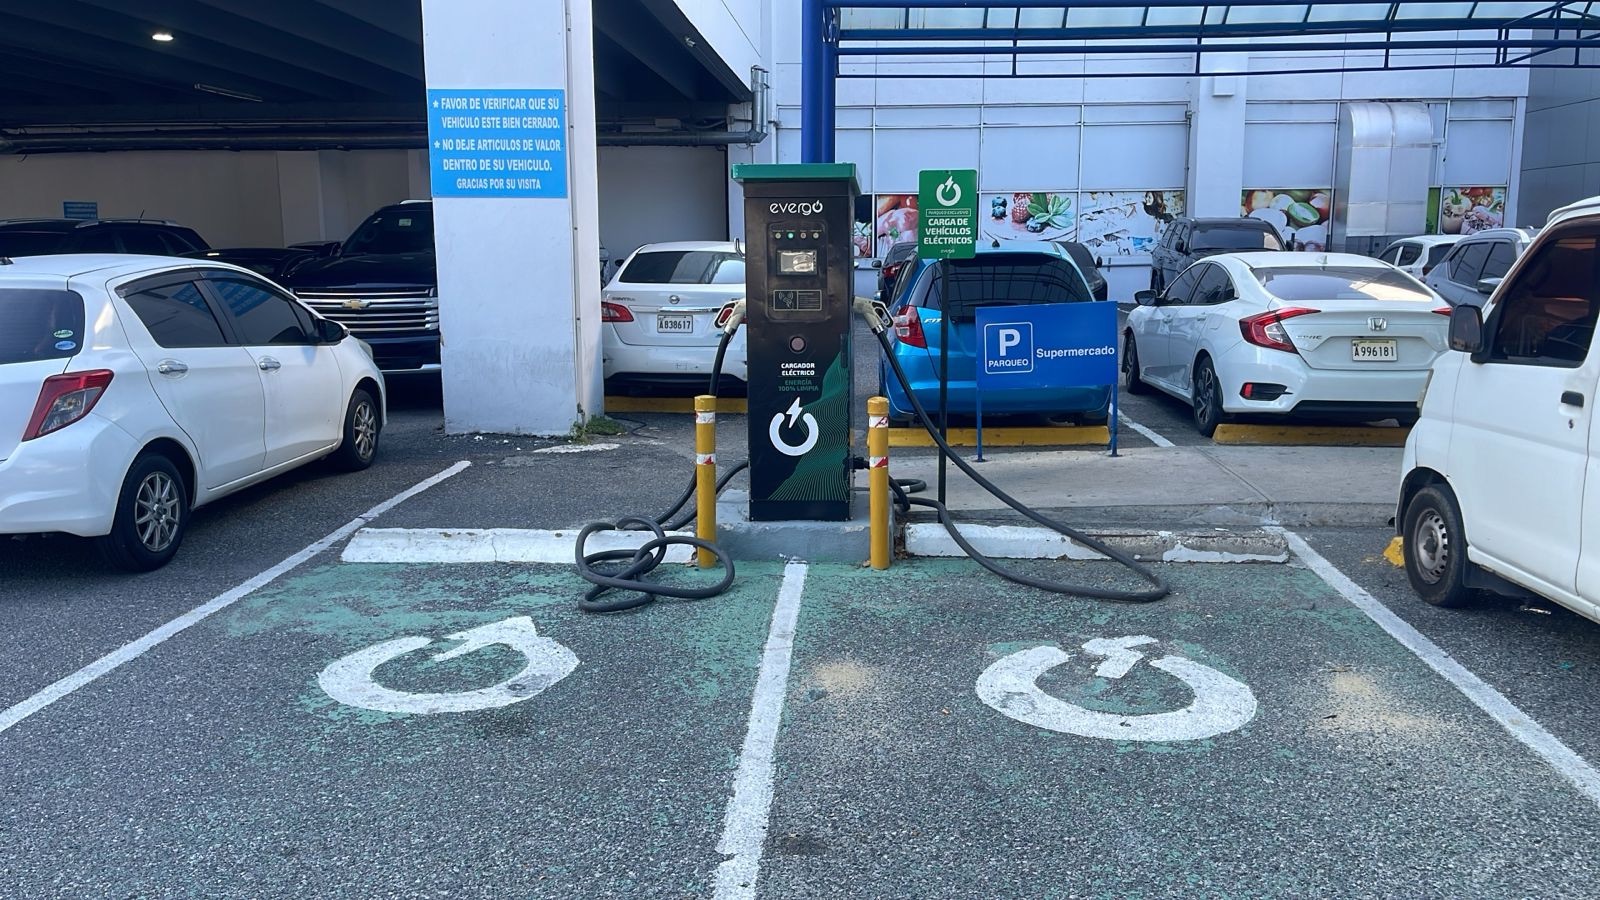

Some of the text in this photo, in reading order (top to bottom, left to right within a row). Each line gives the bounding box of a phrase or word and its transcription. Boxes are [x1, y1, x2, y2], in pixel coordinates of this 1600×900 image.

[441, 98, 559, 110] FAVOR DE VERIFICAR QUE SU
[441, 117, 560, 129] VEHICULO ESTE BIEN CERRADO.
[442, 139, 561, 151] NO DEJE ARTICULOS DE VALOR
[443, 159, 552, 171] DENTRO DE SU VEHICULO.
[456, 178, 541, 189] GRACIAS POR SU VISITA
[769, 200, 823, 216] evergo
[928, 218, 969, 226] CARGA DE
[925, 226, 971, 235] VEHÍCULOS
[923, 235, 973, 245] ELÉCTRICOS
[659, 320, 691, 330] A838617
[1000, 328, 1021, 357] P
[1036, 345, 1115, 359] Supermercado
[1354, 346, 1394, 357] A996181
[988, 358, 1029, 368] PARQUEO
[784, 378, 812, 386] ENERGÍA
